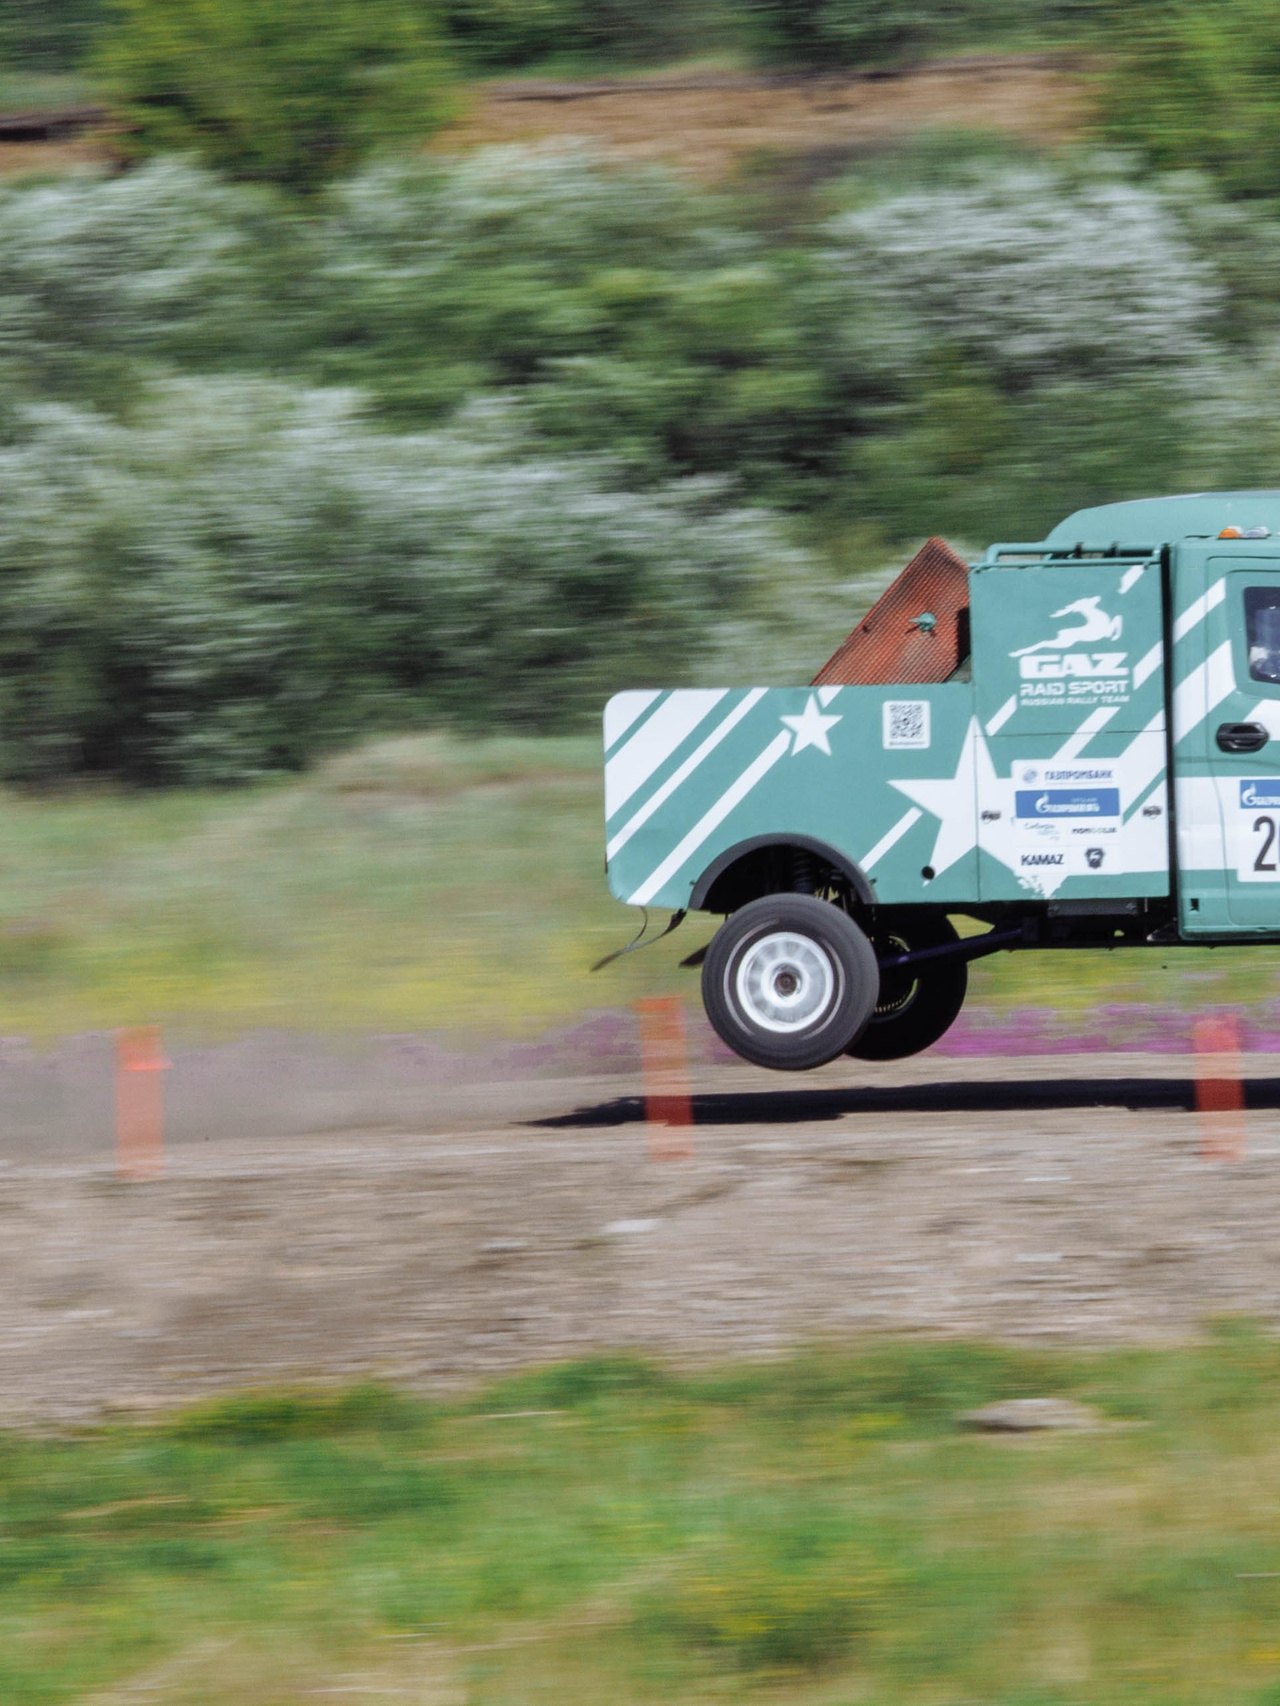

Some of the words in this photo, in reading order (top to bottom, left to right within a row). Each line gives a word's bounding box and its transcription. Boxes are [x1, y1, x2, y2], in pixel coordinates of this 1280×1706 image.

[1019, 652, 1129, 679] GAZ
[1020, 682, 1065, 696] RAID
[1068, 680, 1129, 695] SPORT
[1020, 697, 1065, 706] RUSSIAN
[1101, 695, 1130, 703] TEAM
[1044, 770, 1113, 780] ГАЗПРОМБАНК
[1020, 854, 1065, 866] KAMAZ
